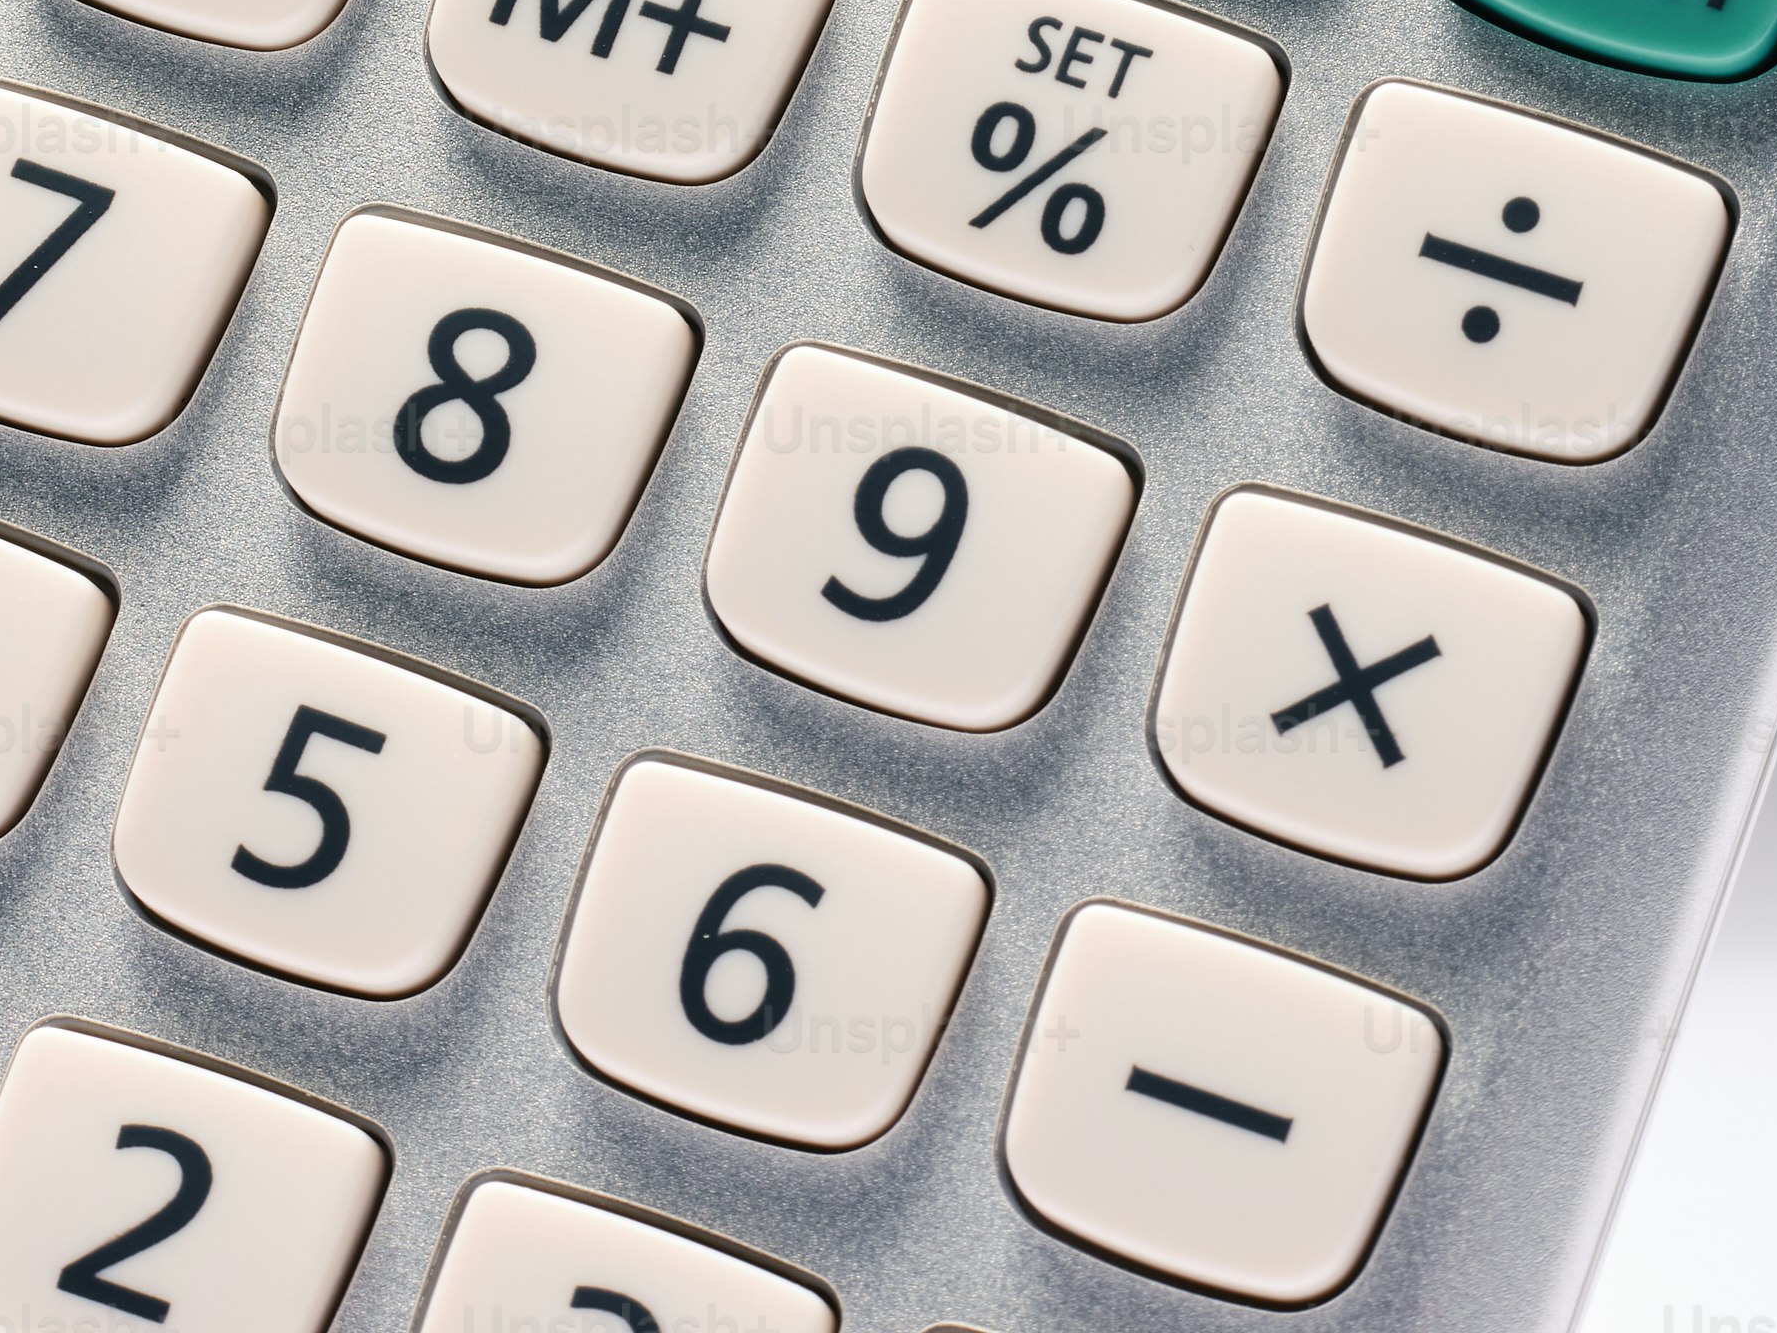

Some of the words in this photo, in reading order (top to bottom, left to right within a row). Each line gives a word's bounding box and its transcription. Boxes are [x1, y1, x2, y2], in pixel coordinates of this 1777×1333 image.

[1015, 17, 1153, 99] SET
[969, 101, 1107, 256] %
[393, 308, 537, 485] 8
[821, 447, 969, 623] 9
[231, 705, 386, 890] 5
[679, 864, 824, 1046] 6
[57, 1124, 213, 1324] 2
